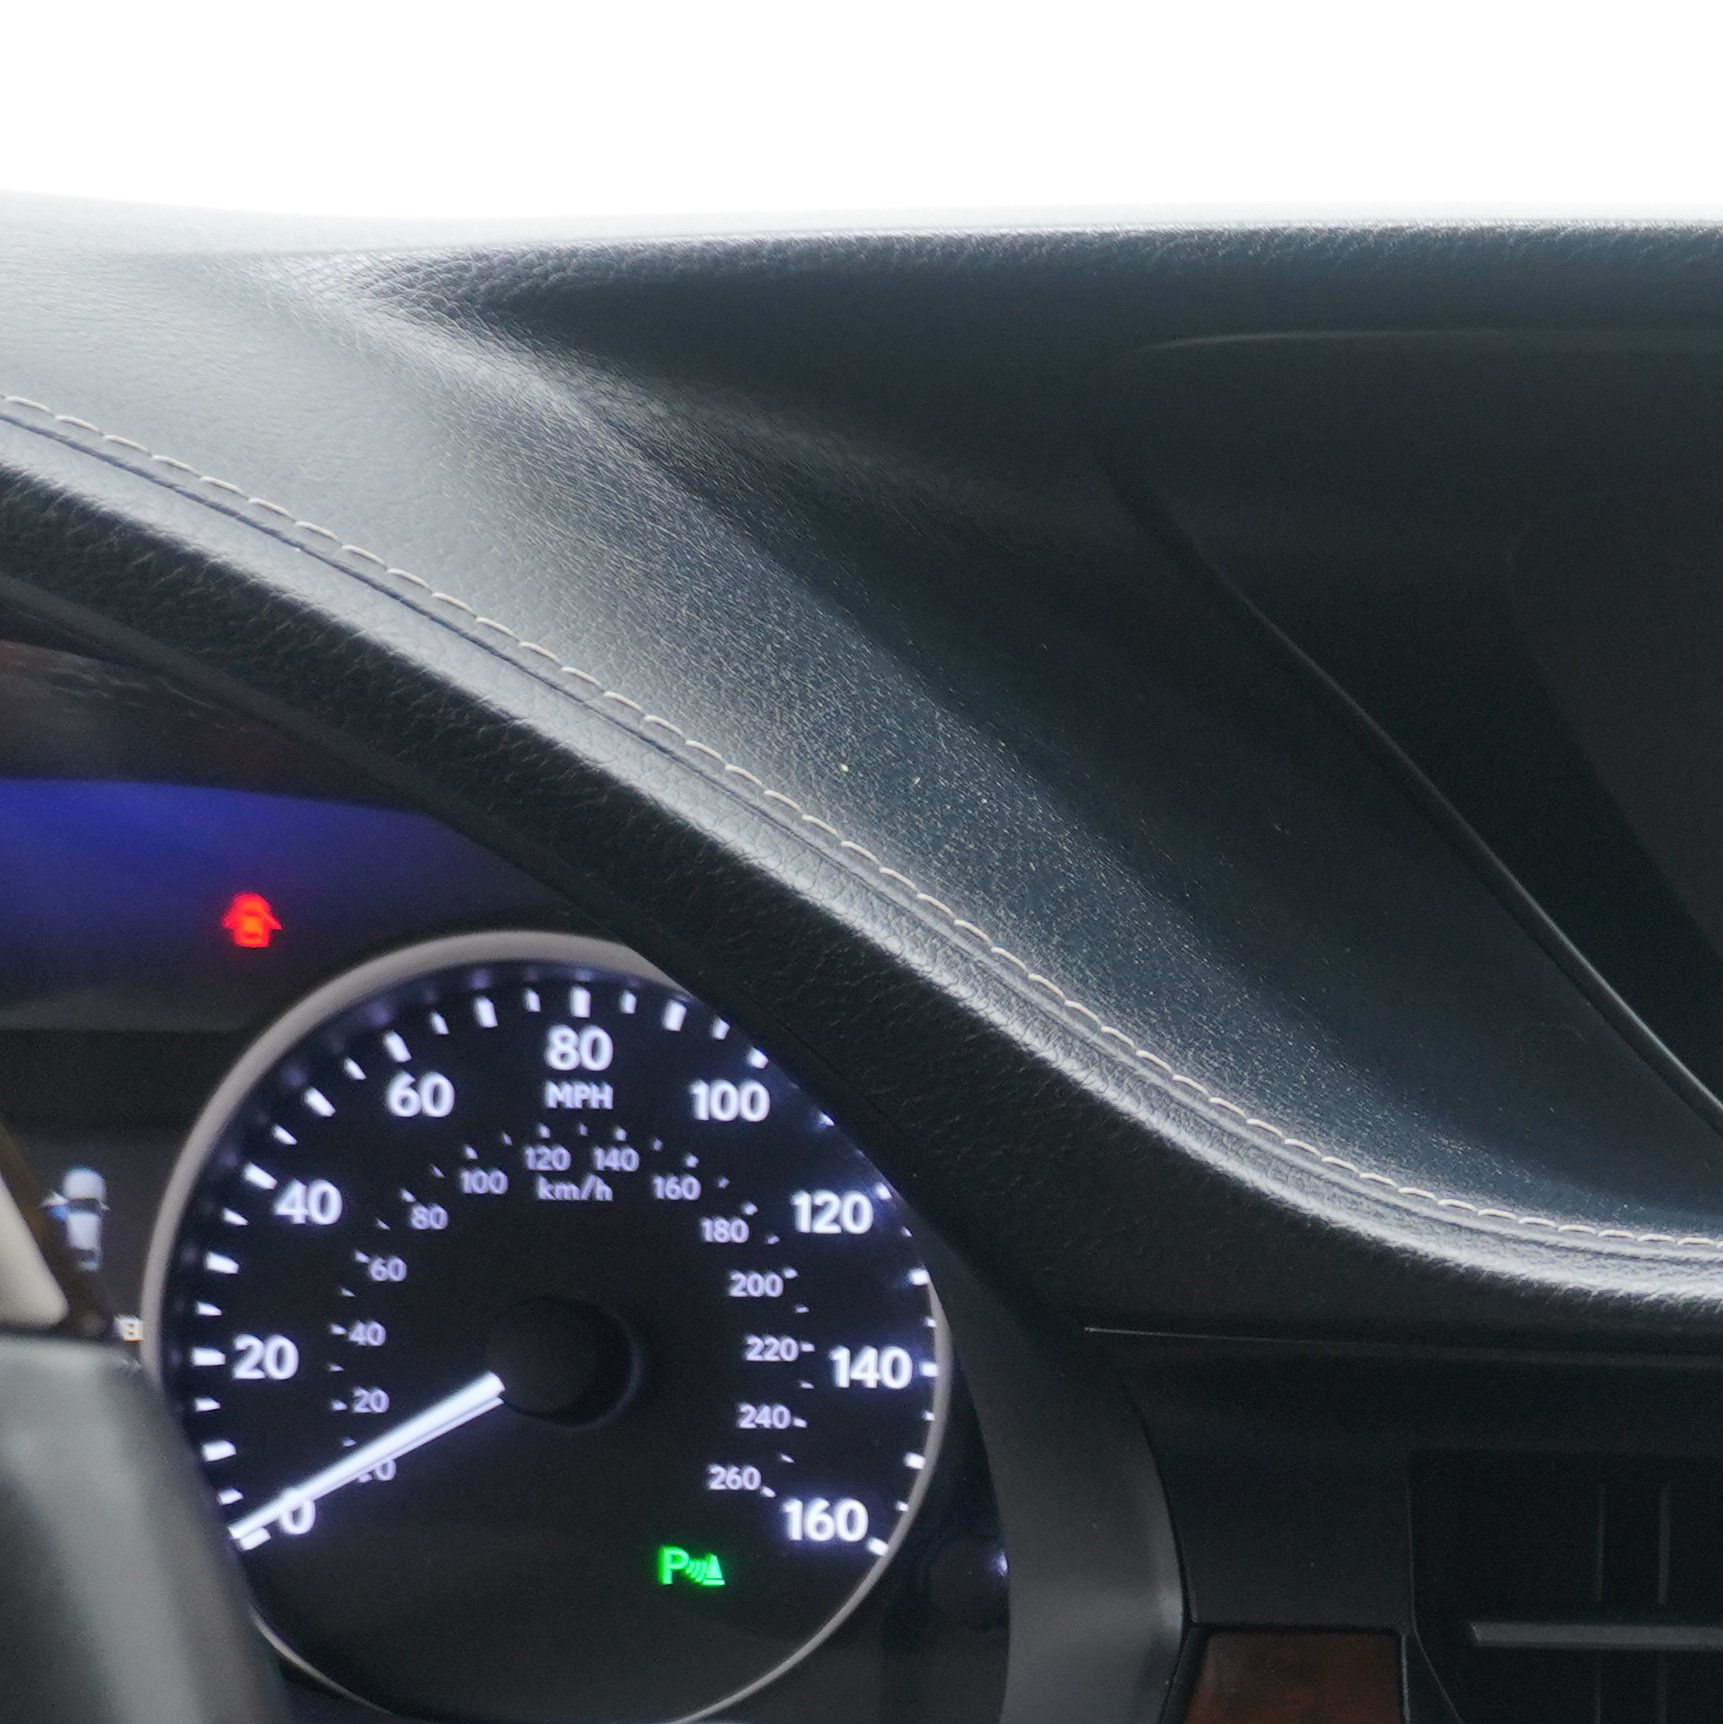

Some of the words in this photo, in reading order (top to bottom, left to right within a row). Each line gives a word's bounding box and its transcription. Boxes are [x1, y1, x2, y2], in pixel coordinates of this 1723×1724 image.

[546, 1025, 613, 1071] 80
[388, 1073, 454, 1118] 60
[545, 1081, 613, 1110] MPH
[690, 1079, 770, 1122] 100
[524, 1145, 571, 1172] 120
[592, 1145, 640, 1172] 140
[460, 1169, 509, 1195] 100
[537, 1174, 613, 1201] km/h
[652, 1175, 702, 1200] 160
[275, 1178, 343, 1226] 40
[791, 1190, 873, 1234] 120
[410, 1203, 448, 1230] 80
[700, 1217, 749, 1243] 180
[368, 1257, 408, 1281] 60
[728, 1271, 784, 1297] 200
[349, 1321, 387, 1346] 40
[233, 1334, 299, 1380] 20
[745, 1335, 799, 1361] 220
[829, 1346, 912, 1389] 140
[352, 1387, 390, 1413] 20
[736, 1402, 791, 1429] 240
[707, 1465, 761, 1491] 260
[783, 1498, 868, 1542] 160
